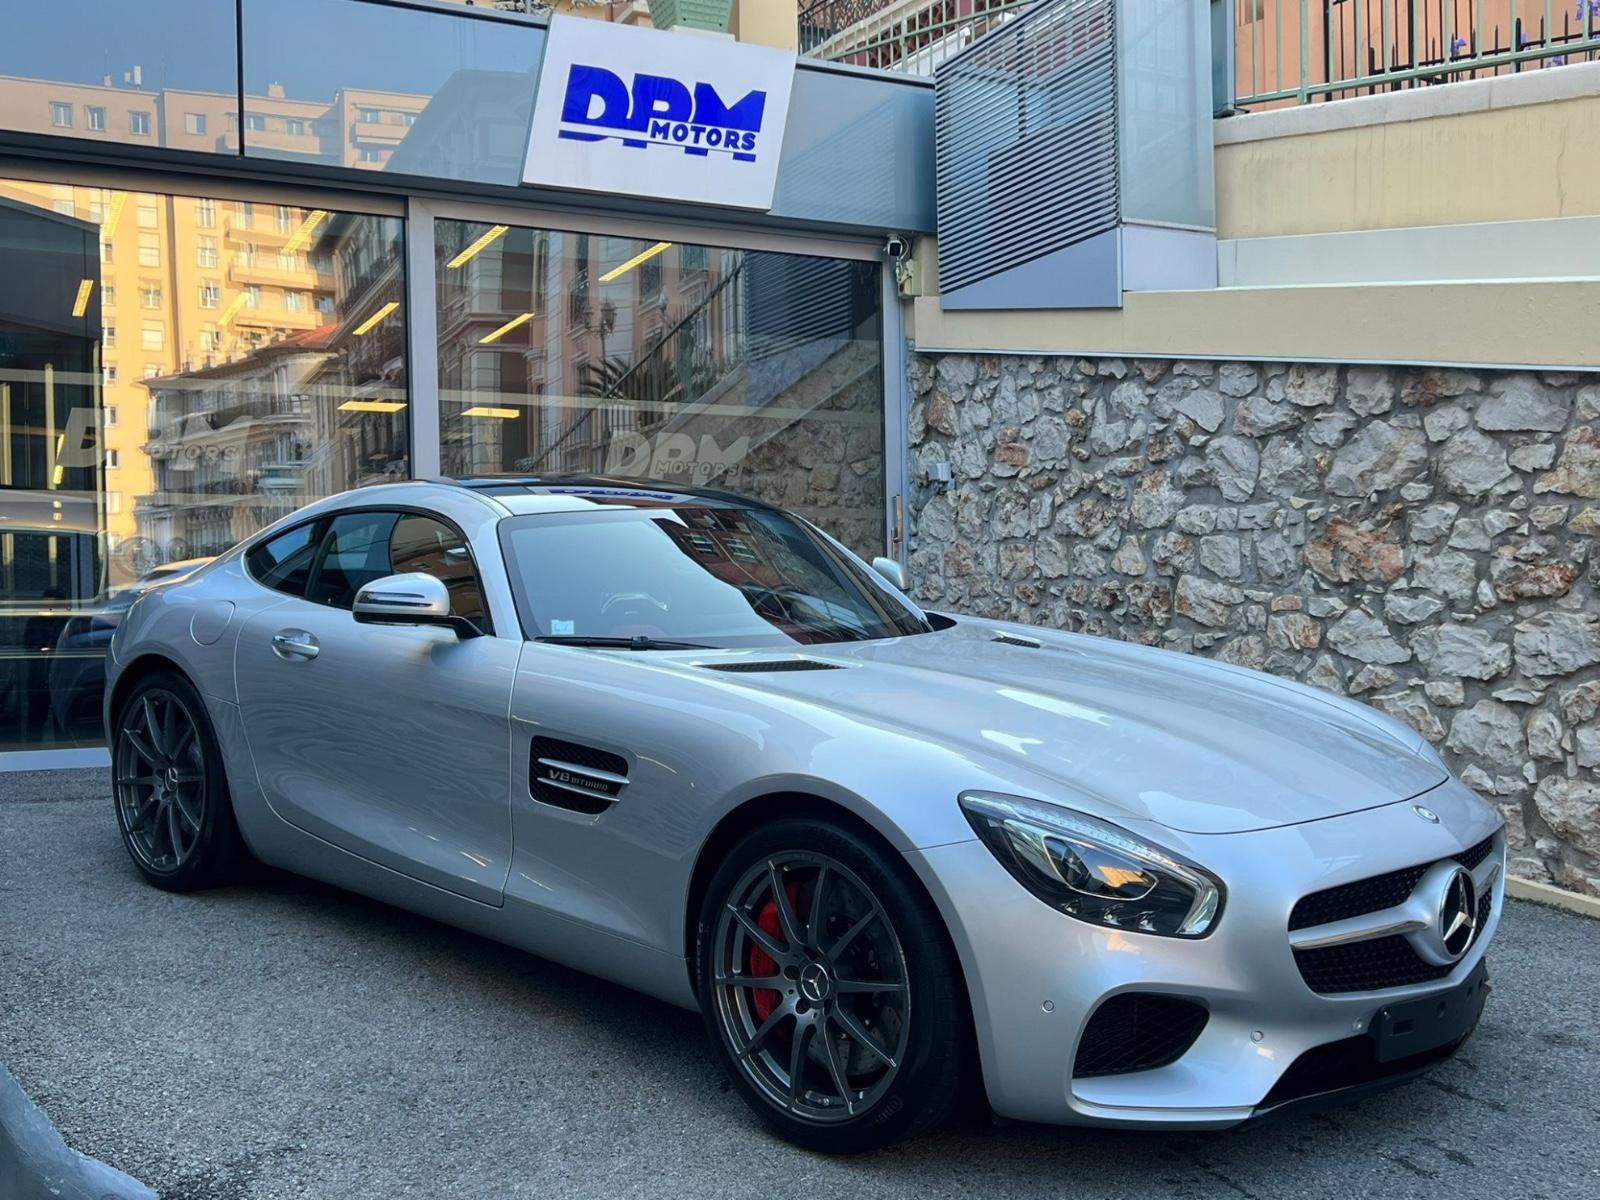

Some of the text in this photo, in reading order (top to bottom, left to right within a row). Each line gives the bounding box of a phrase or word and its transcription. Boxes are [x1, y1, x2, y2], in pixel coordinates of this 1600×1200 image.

[558, 64, 767, 163] DPM
[650, 121, 756, 151] MOTORS
[130, 444, 239, 464] OTORS
[655, 460, 738, 477] MOTORS
[548, 769, 570, 782] V8
